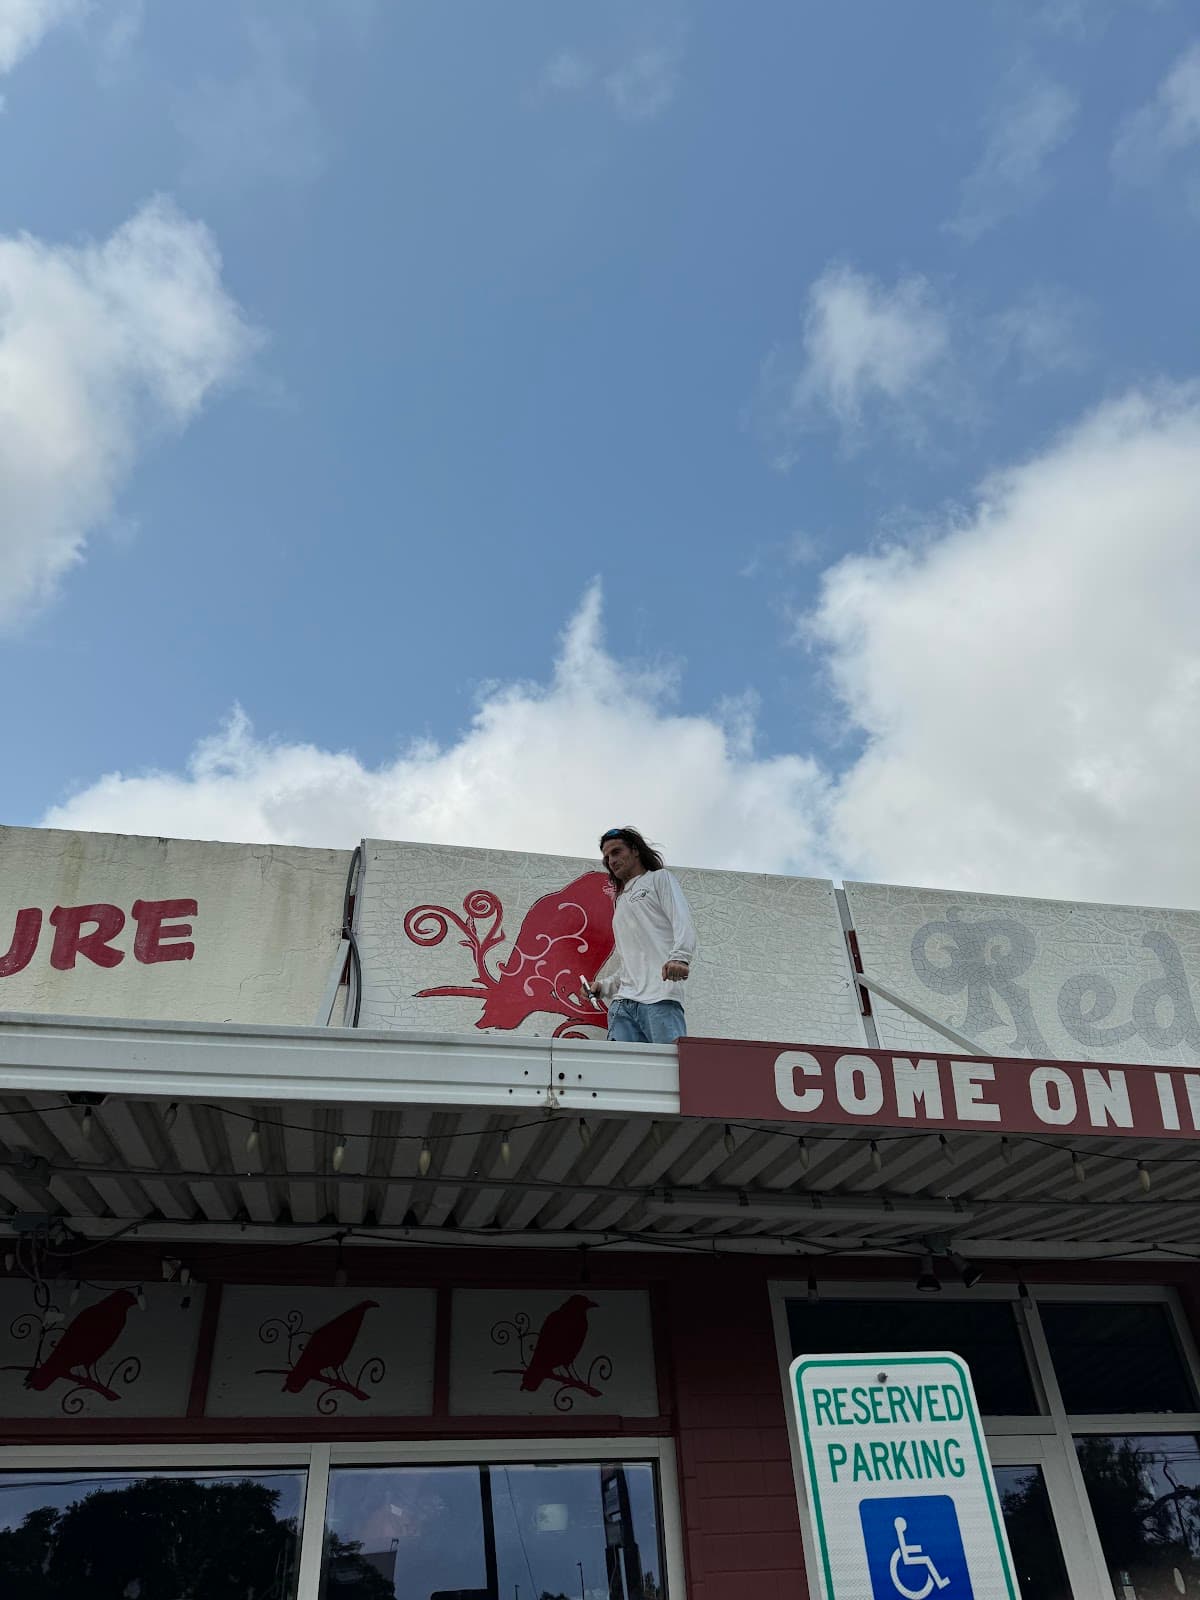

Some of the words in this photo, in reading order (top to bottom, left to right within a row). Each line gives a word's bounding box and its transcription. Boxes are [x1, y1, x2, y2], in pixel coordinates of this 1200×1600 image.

[774, 1050, 1002, 1122] COME
[1029, 1066, 1134, 1129] ON
[812, 1384, 964, 1426] RESERVED
[827, 1438, 966, 1483] PARKING
